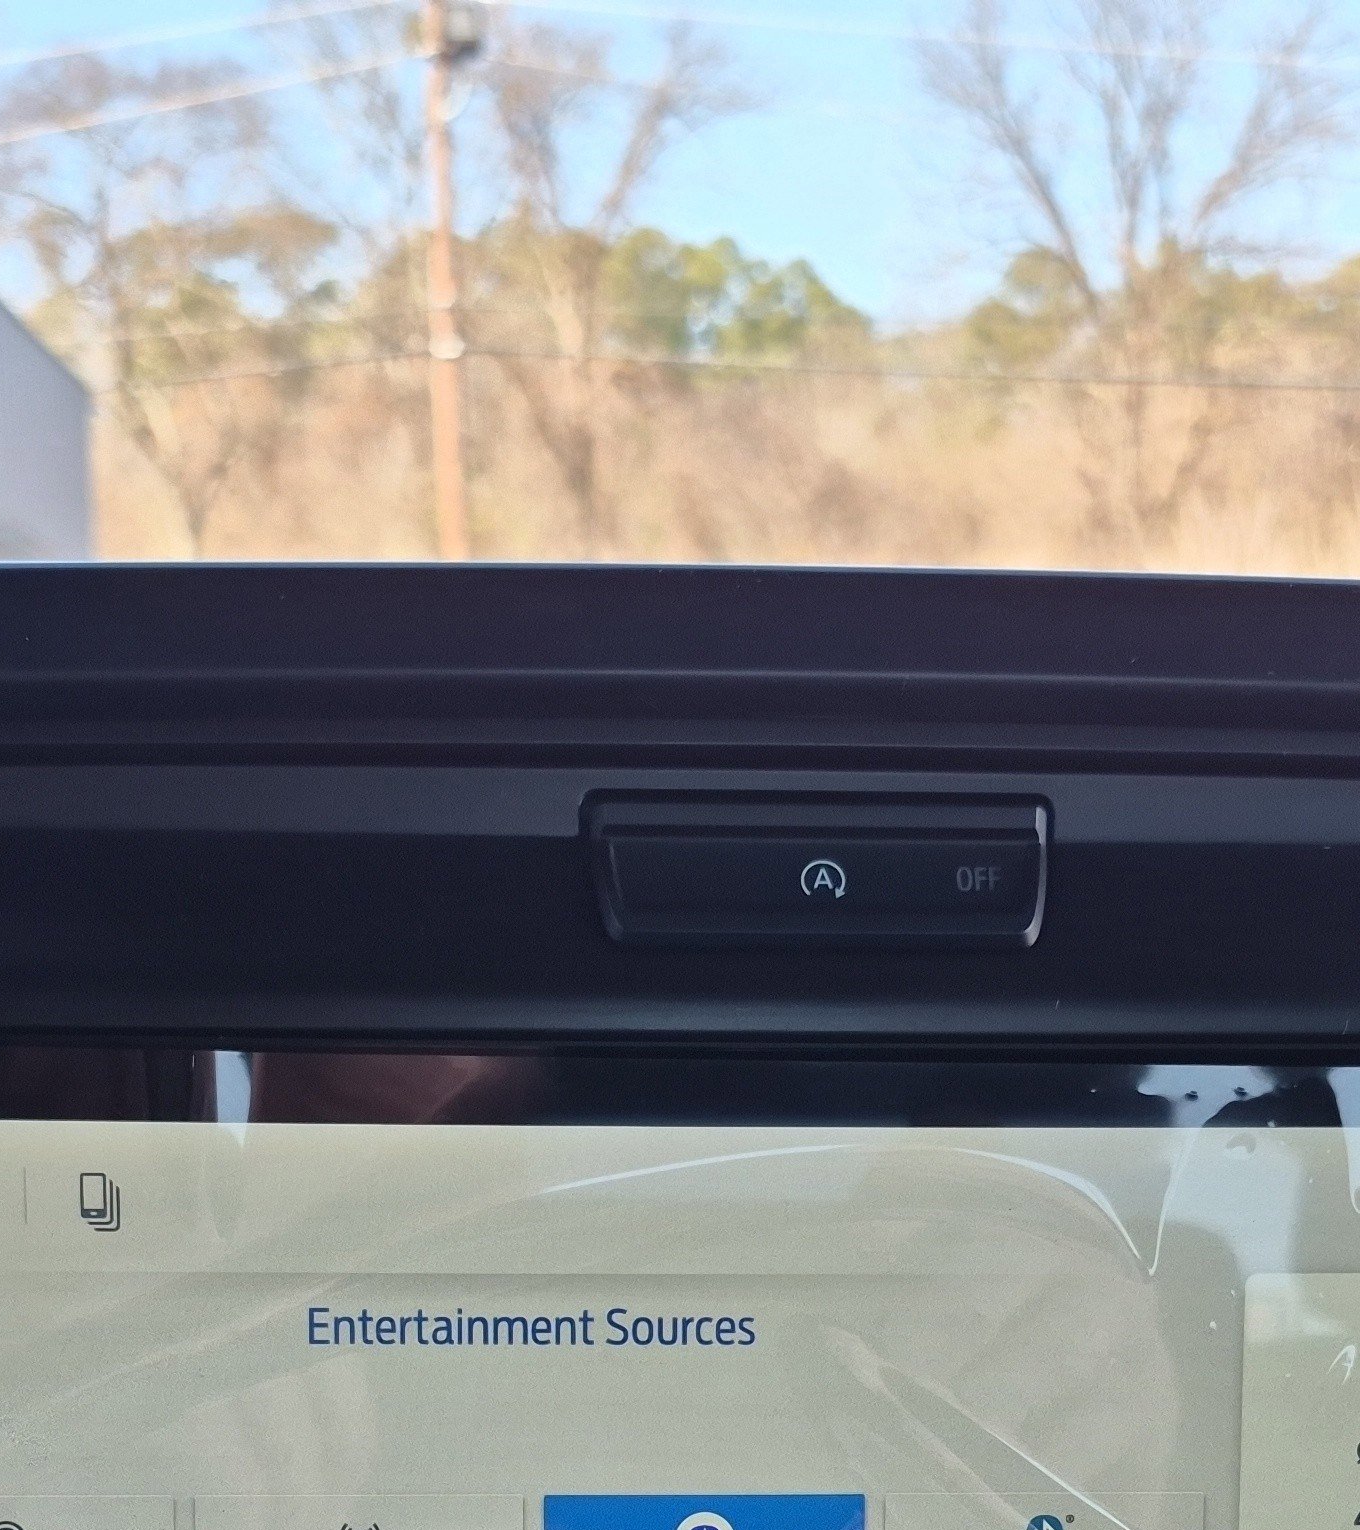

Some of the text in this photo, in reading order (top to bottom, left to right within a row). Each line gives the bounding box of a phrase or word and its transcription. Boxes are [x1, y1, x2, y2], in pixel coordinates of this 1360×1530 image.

[956, 867, 1002, 892] OFF
[307, 1307, 756, 1346] Entertainment Sources
